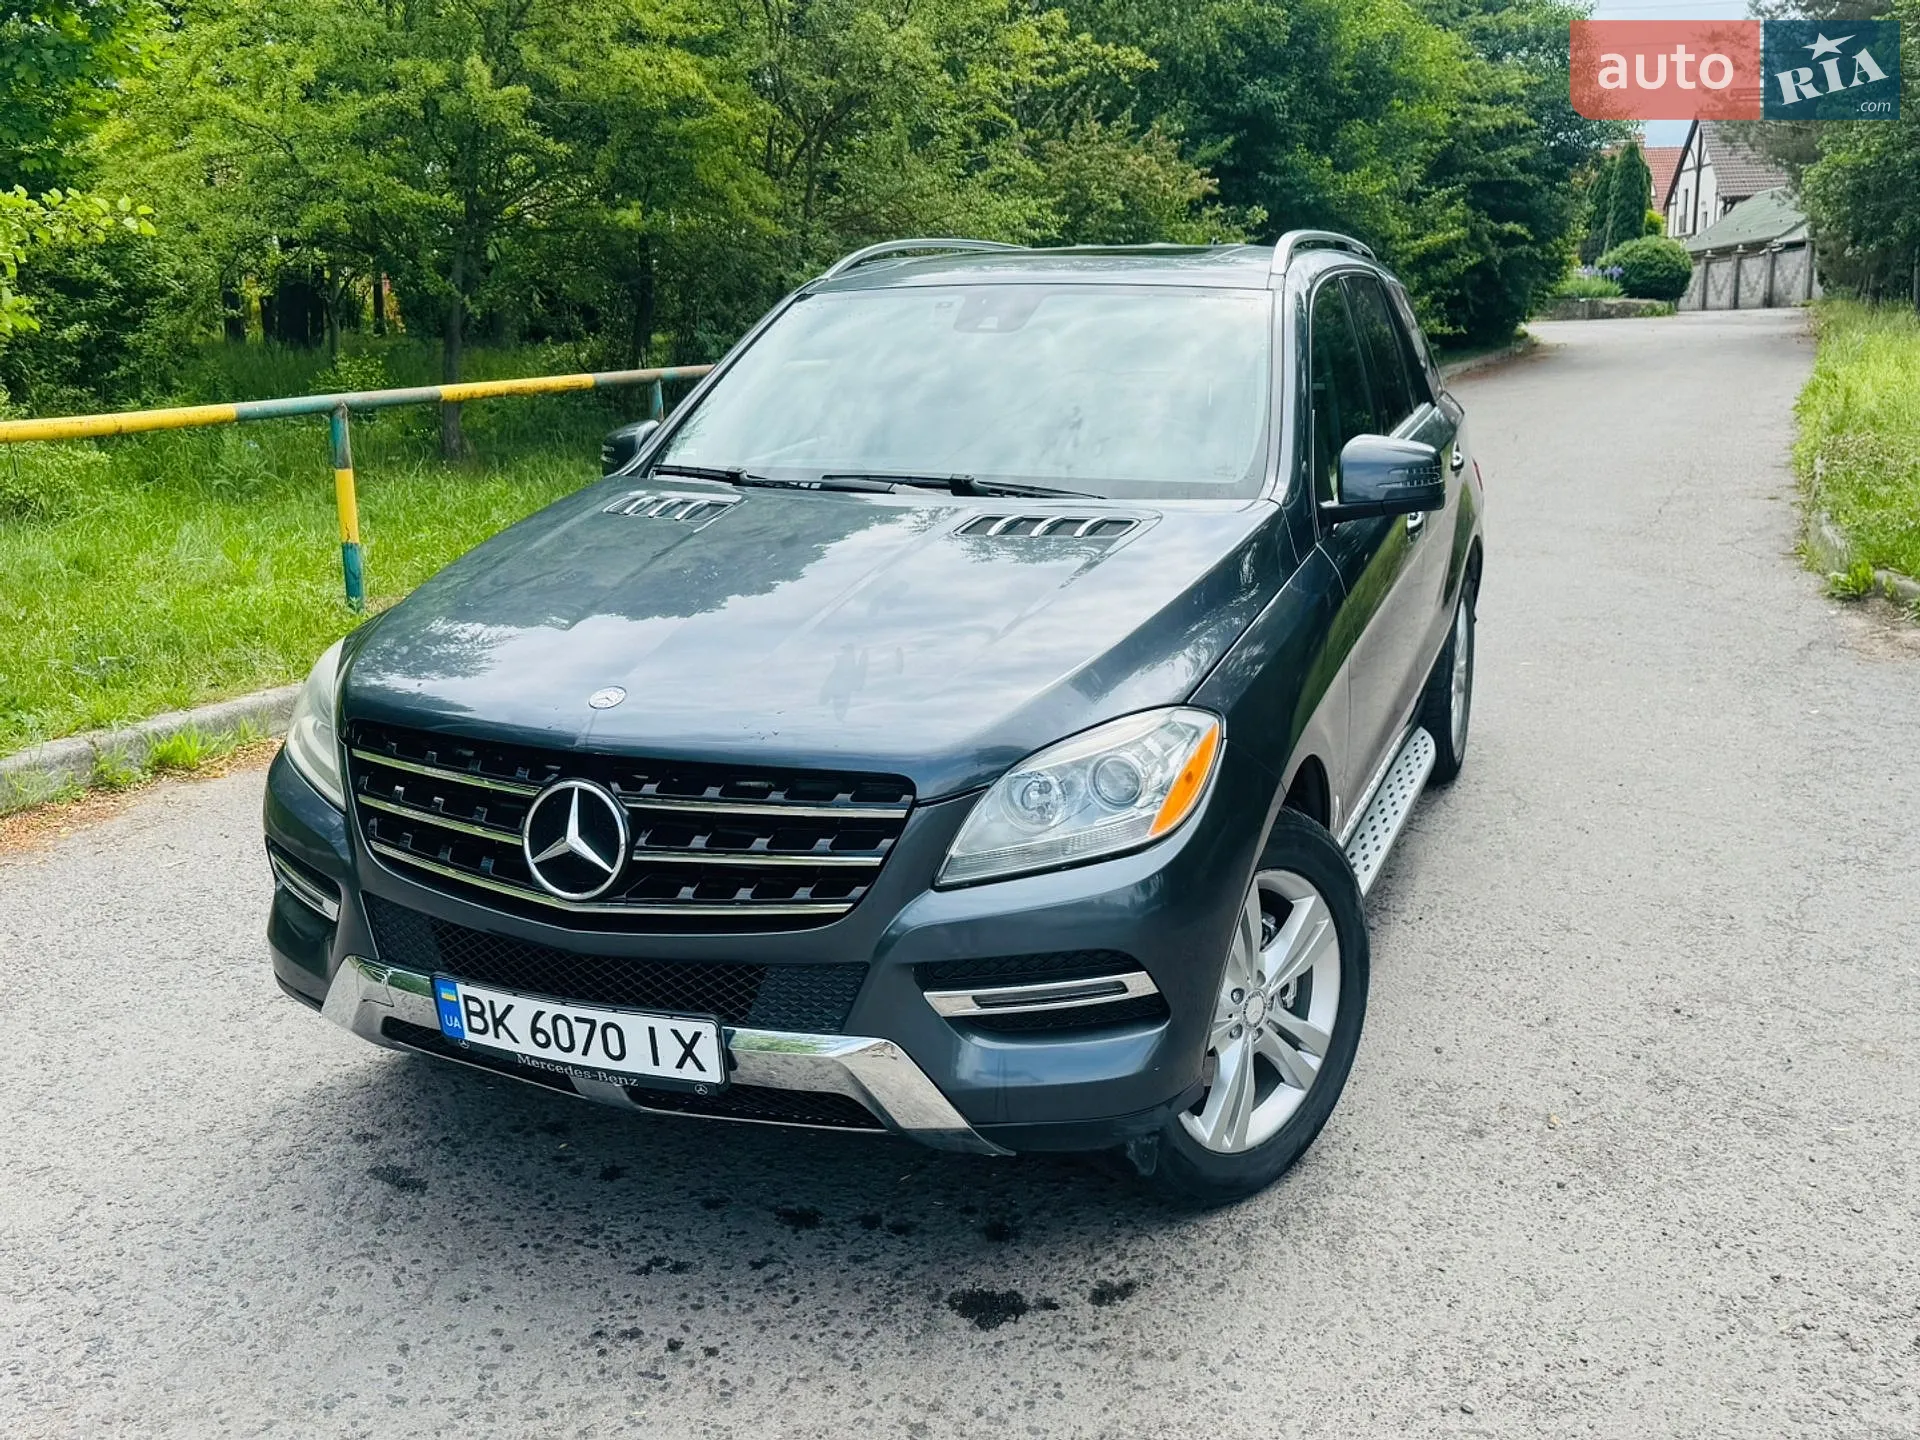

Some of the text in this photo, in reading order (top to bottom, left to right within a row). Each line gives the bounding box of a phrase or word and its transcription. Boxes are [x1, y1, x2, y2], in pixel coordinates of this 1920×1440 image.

[445, 1014, 461, 1030] UA
[462, 994, 520, 1044] BK
[530, 1010, 627, 1062] 6070
[516, 1053, 639, 1087] Mercedes-Benz
